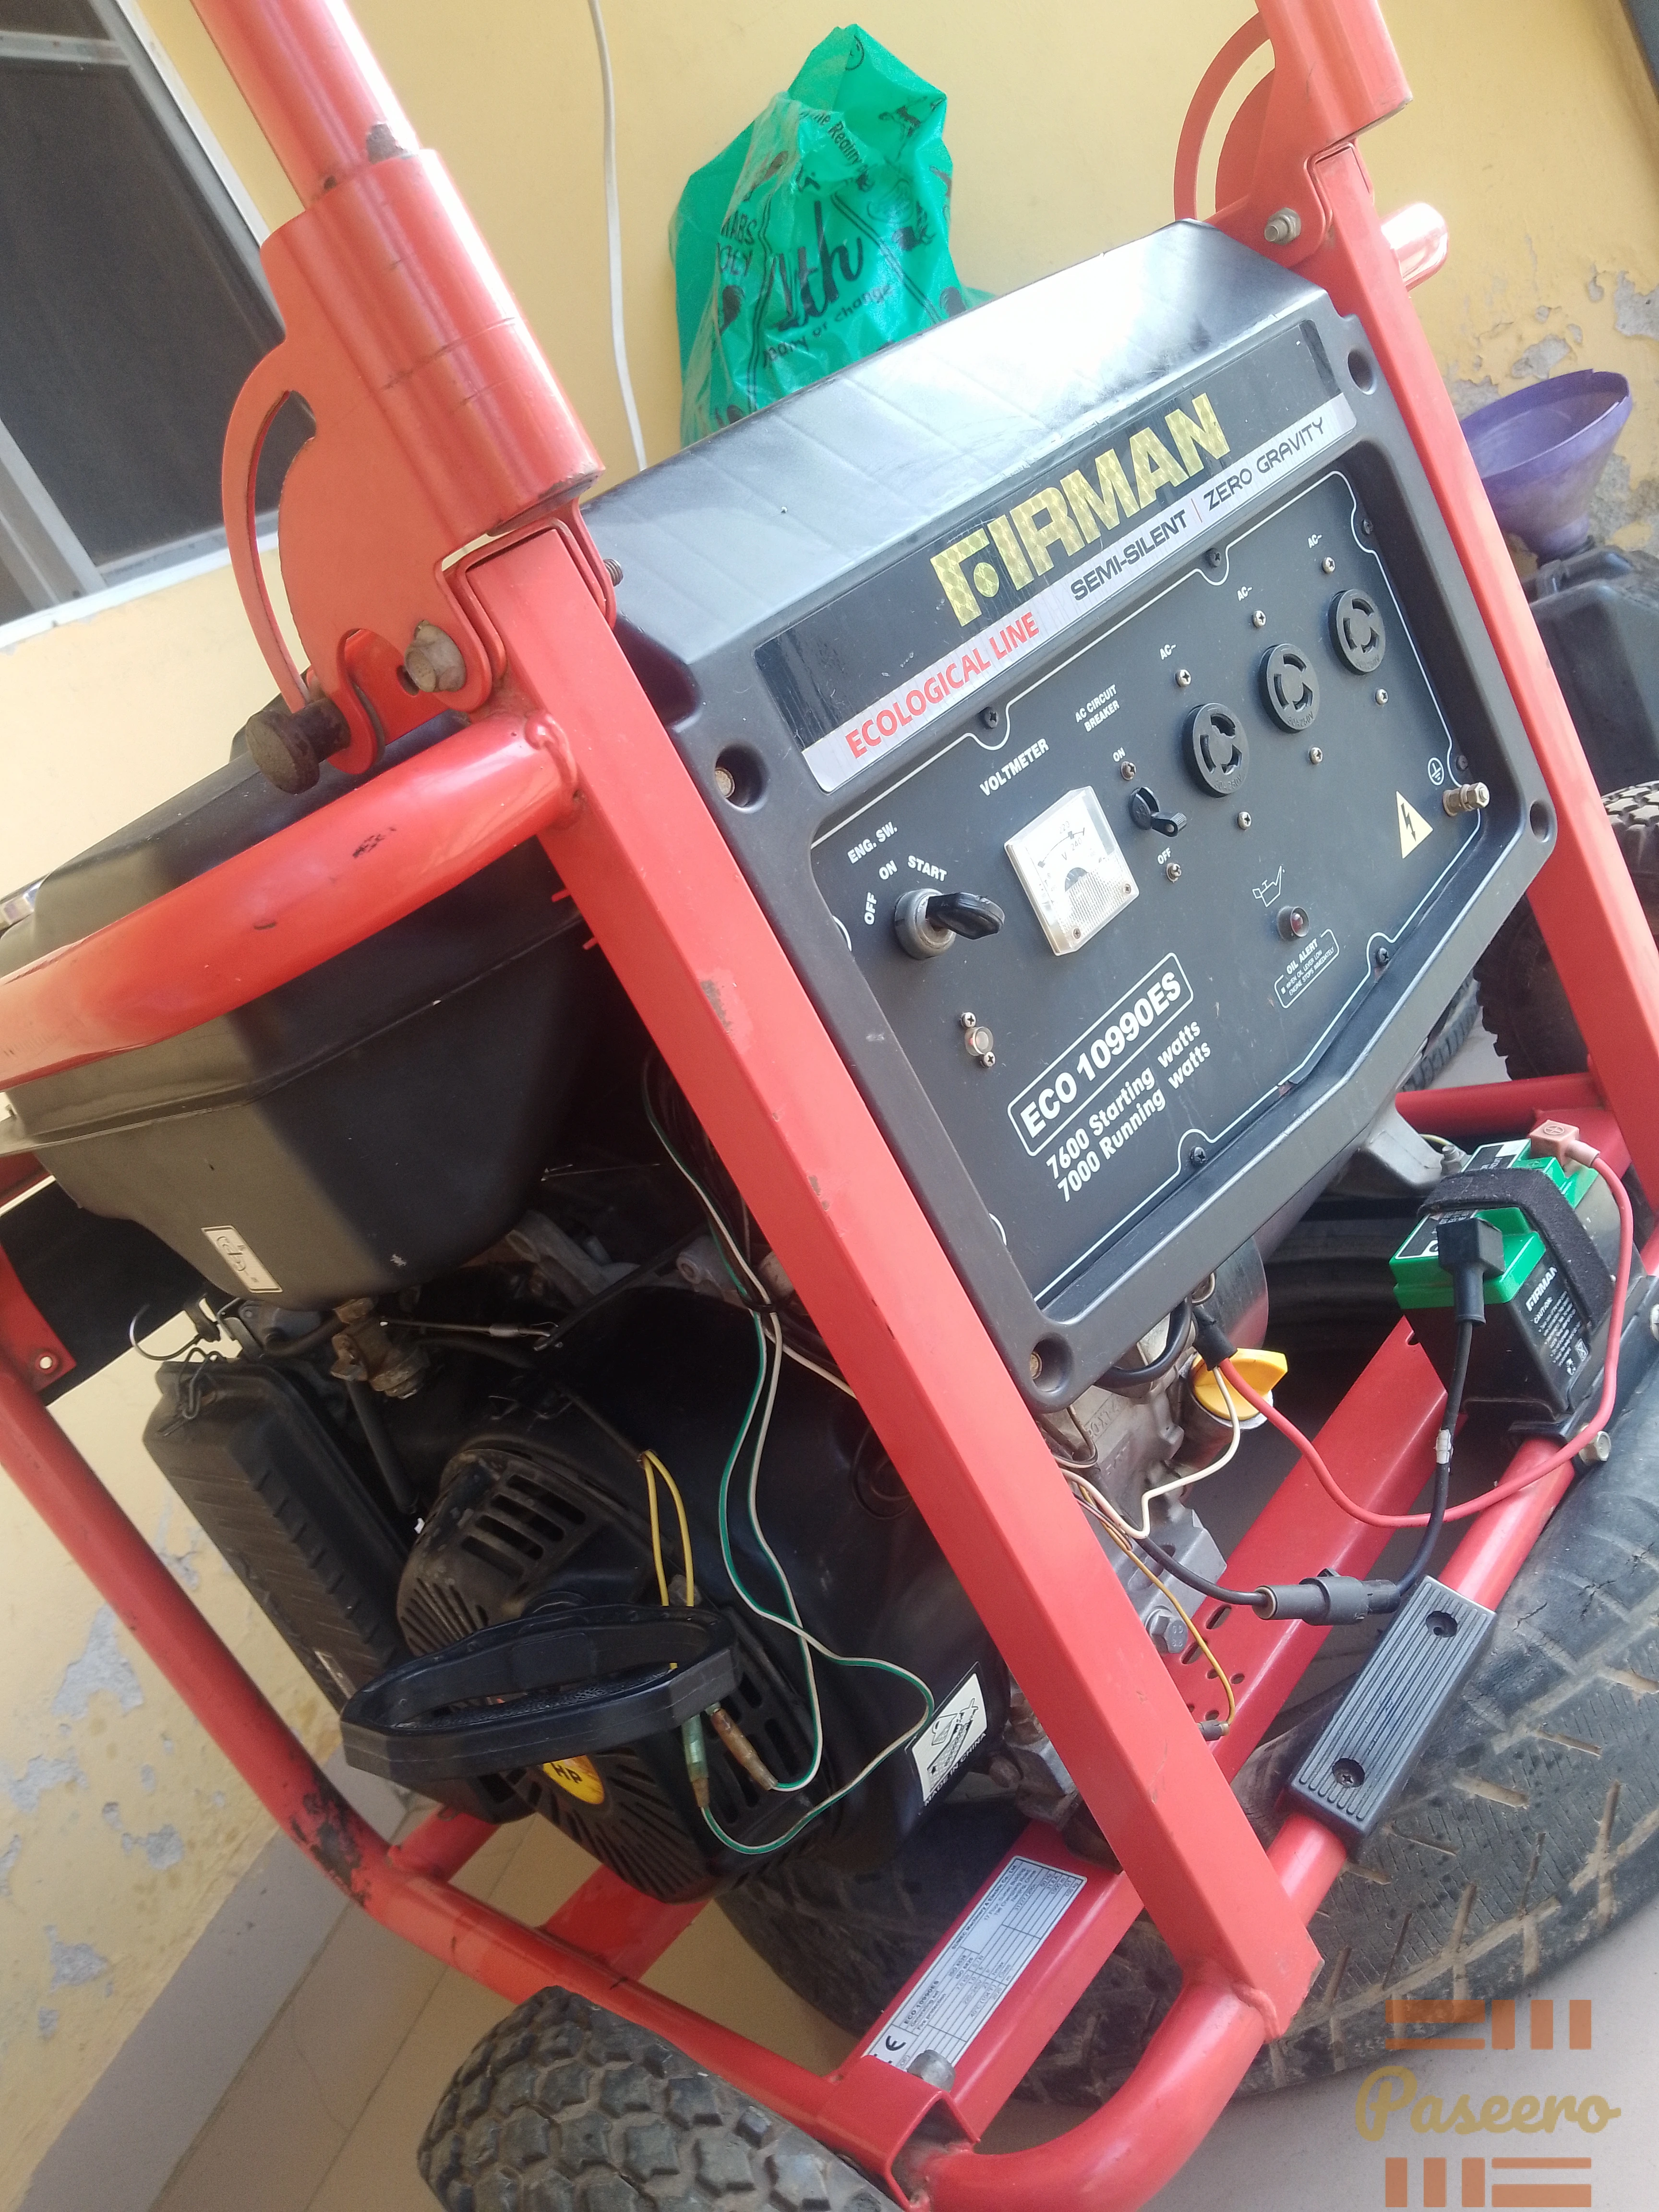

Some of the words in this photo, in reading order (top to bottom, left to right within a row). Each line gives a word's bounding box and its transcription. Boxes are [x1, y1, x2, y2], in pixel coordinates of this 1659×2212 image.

[930, 392, 1230, 627] FIRMAN
[1070, 509, 1188, 601] SEMI-SILENT
[1203, 468, 1253, 512] ZERO
[1256, 416, 1325, 473] GRAVITY
[845, 648, 991, 759] ECOLOGICAL
[991, 612, 1040, 660] LINE
[1074, 707, 1093, 723] AC
[1090, 684, 1118, 715] CIRCUIT
[1084, 699, 1120, 733] BREAKER
[979, 738, 1049, 796] VOLTMETER
[1112, 747, 1126, 762] ON
[847, 836, 878, 864] ENG.
[877, 821, 898, 846] SW.
[1070, 837, 1082, 851] 240
[1156, 847, 1172, 864] OFF
[878, 861, 898, 880] ON
[907, 855, 947, 881] START
[864, 892, 878, 926] OFF
[1286, 960, 1299, 975] OIL
[1299, 938, 1319, 963] ALERT
[1302, 968, 1315, 983] STOPS
[1019, 1071, 1078, 1139] ECO
[1075, 971, 1182, 1082] 10990ES
[1046, 1130, 1090, 1180] 7600
[1088, 1066, 1155, 1136] Starting
[1157, 1021, 1201, 1068] watts
[1057, 1152, 1101, 1202] 7000
[1098, 1088, 1166, 1160] Running
[1168, 1042, 1211, 1089] watts
[1525, 1266, 1558, 1312] FIRMAN
[924, 1775, 949, 1807] MADE
[950, 1763, 959, 1776] IN
[960, 1732, 986, 1763] CHINA
[903, 2009, 917, 2024] ECO
[915, 1980, 940, 2008] 10990ES
